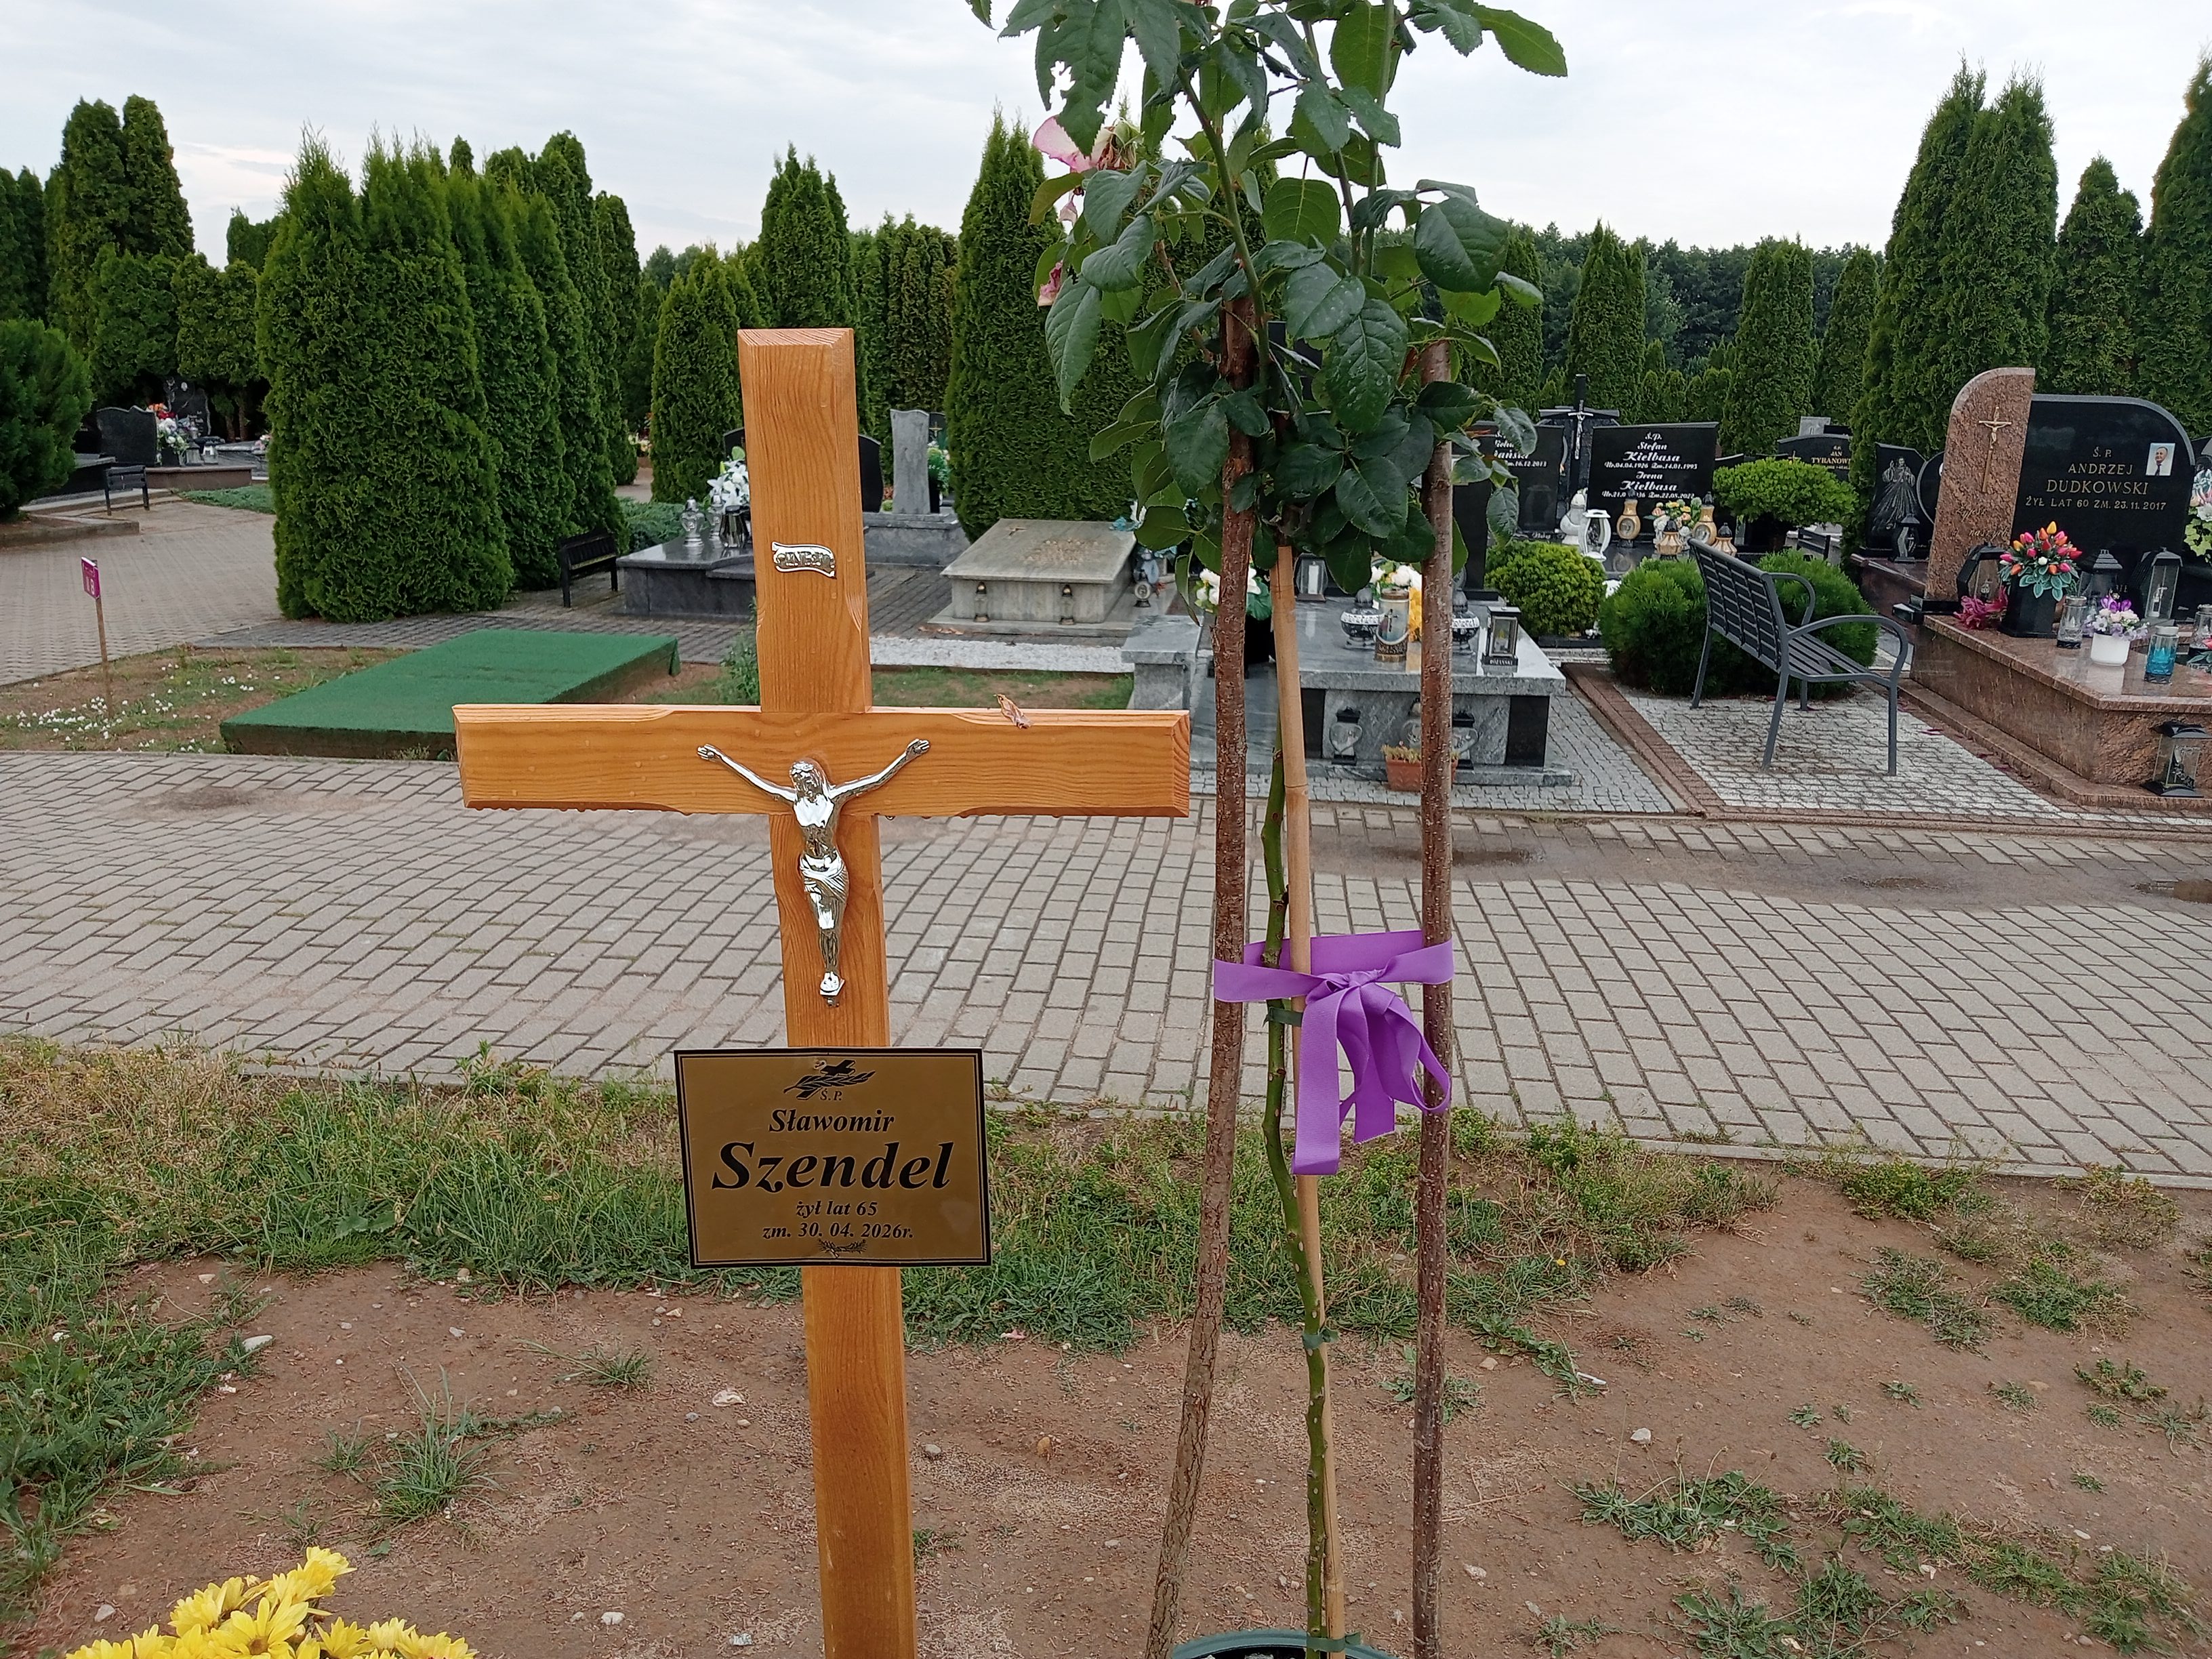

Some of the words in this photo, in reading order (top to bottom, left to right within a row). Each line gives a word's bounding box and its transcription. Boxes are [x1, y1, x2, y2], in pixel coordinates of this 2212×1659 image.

[1637, 442, 1667, 451] Stefan
[1636, 471, 1664, 480] Irena
[2068, 463, 2133, 475] ANDRZEJ
[2046, 479, 2149, 495] DUDKOWSKI
[2025, 495, 2045, 507] ŻYŁ
[2051, 498, 2072, 507] LAT
[2076, 499, 2089, 508] 60
[2094, 500, 2111, 508] ZM.
[769, 1109, 895, 1133] Sławomir
[711, 1141, 955, 1193] Szendel
[796, 1201, 821, 1218] żył
[827, 1201, 851, 1216] lat
[856, 1201, 878, 1216] 65
[762, 1226, 792, 1240] zm.
[798, 1223, 823, 1237] 30.
[829, 1223, 855, 1237] 04.
[861, 1223, 914, 1239] 2026r.
